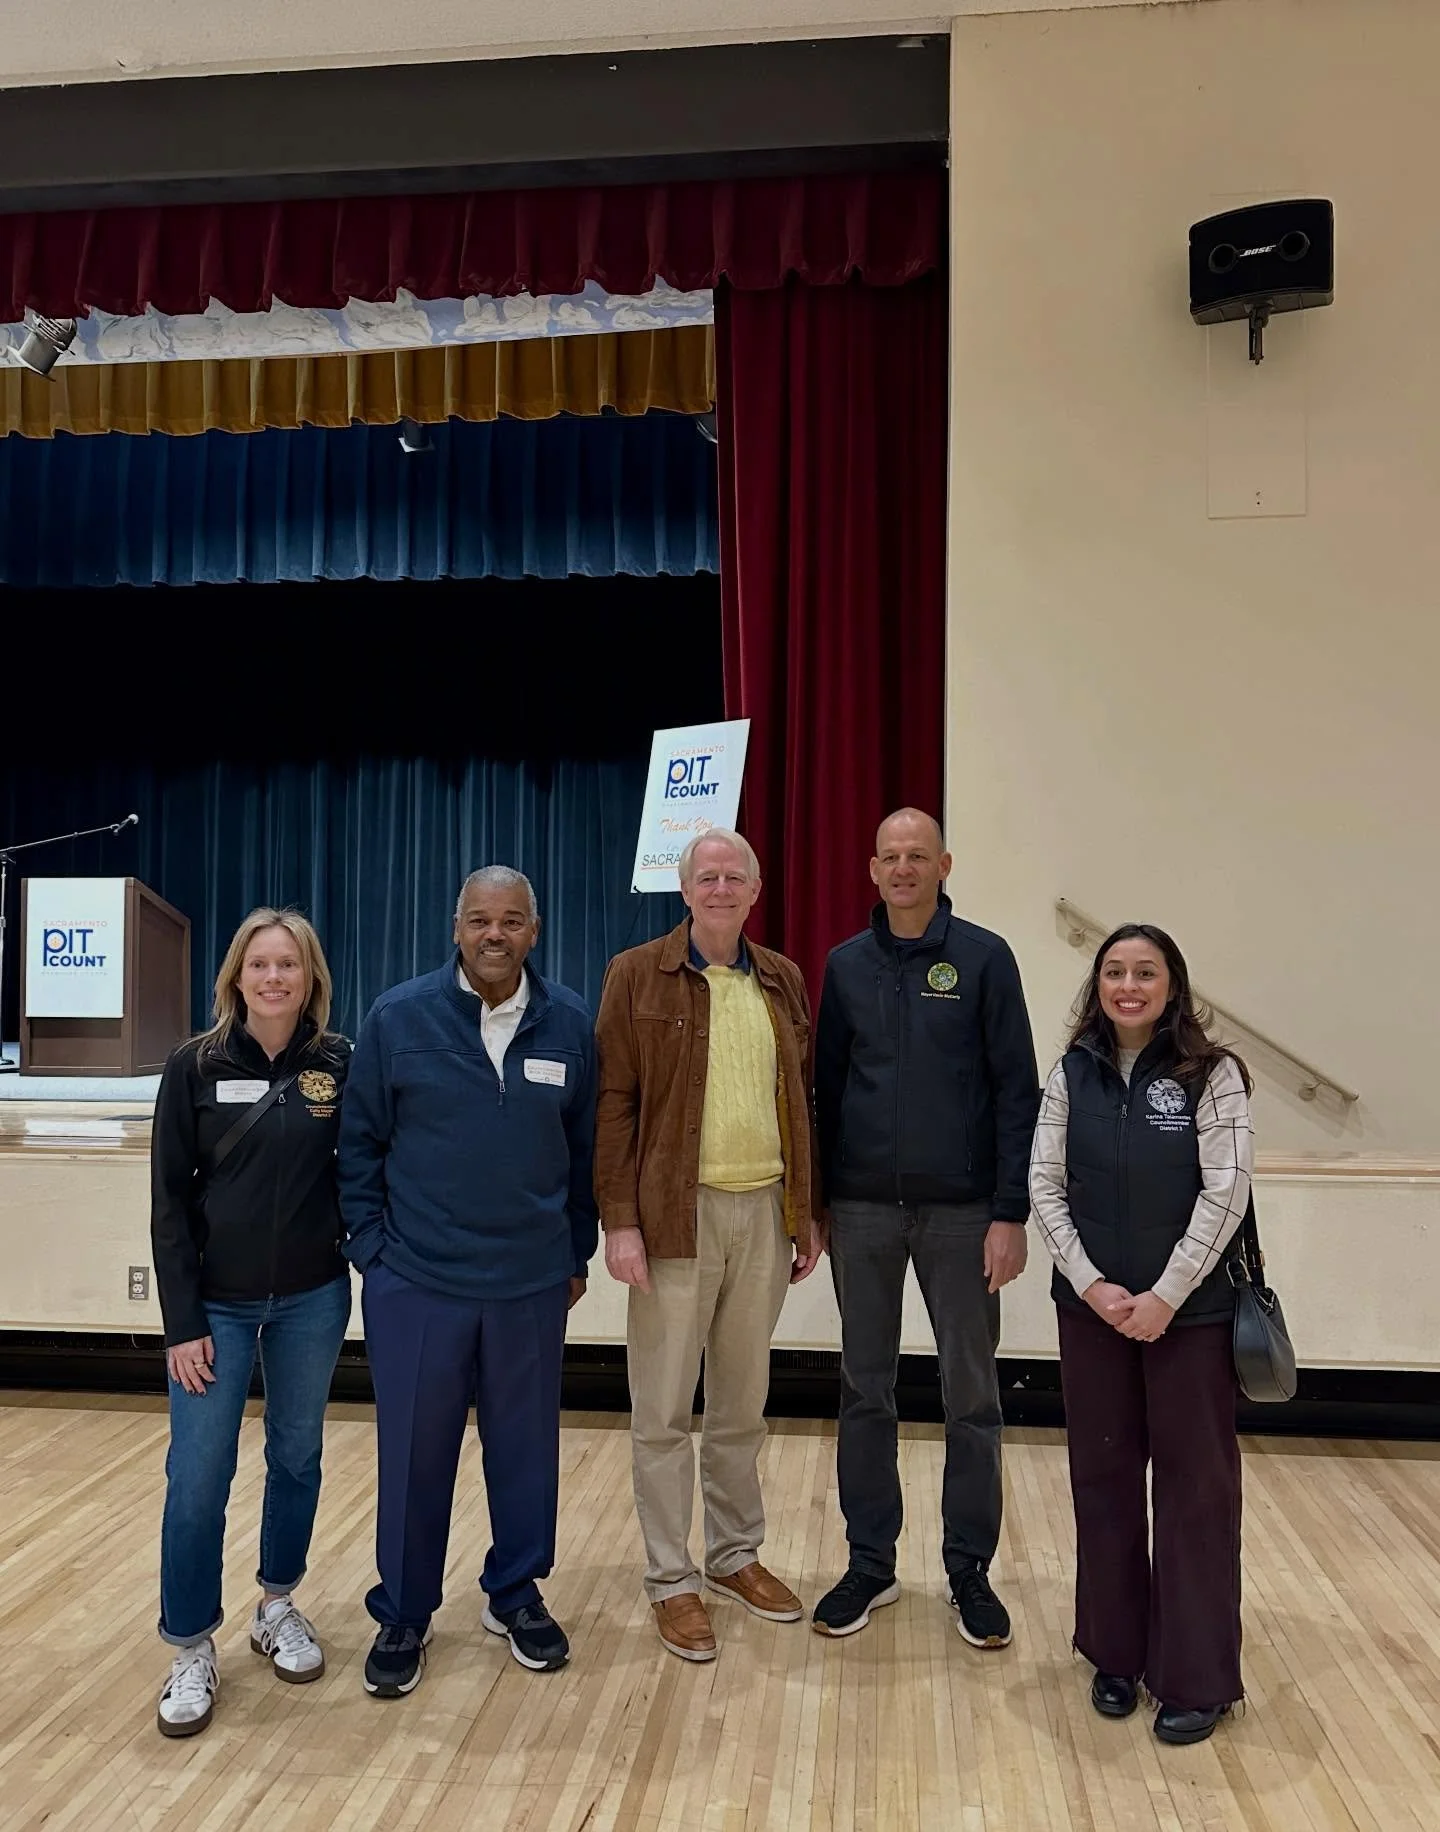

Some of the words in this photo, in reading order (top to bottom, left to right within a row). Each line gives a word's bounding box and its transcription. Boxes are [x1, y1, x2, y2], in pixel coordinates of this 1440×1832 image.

[1240, 245, 1276, 257] BOSE
[671, 745, 724, 757] SACRAMENTO
[670, 782, 720, 798] COUNT
[660, 817, 691, 833] Thank
[694, 816, 712, 835] You
[43, 920, 108, 928] SACRAMENTO
[49, 955, 107, 967] COUNT
